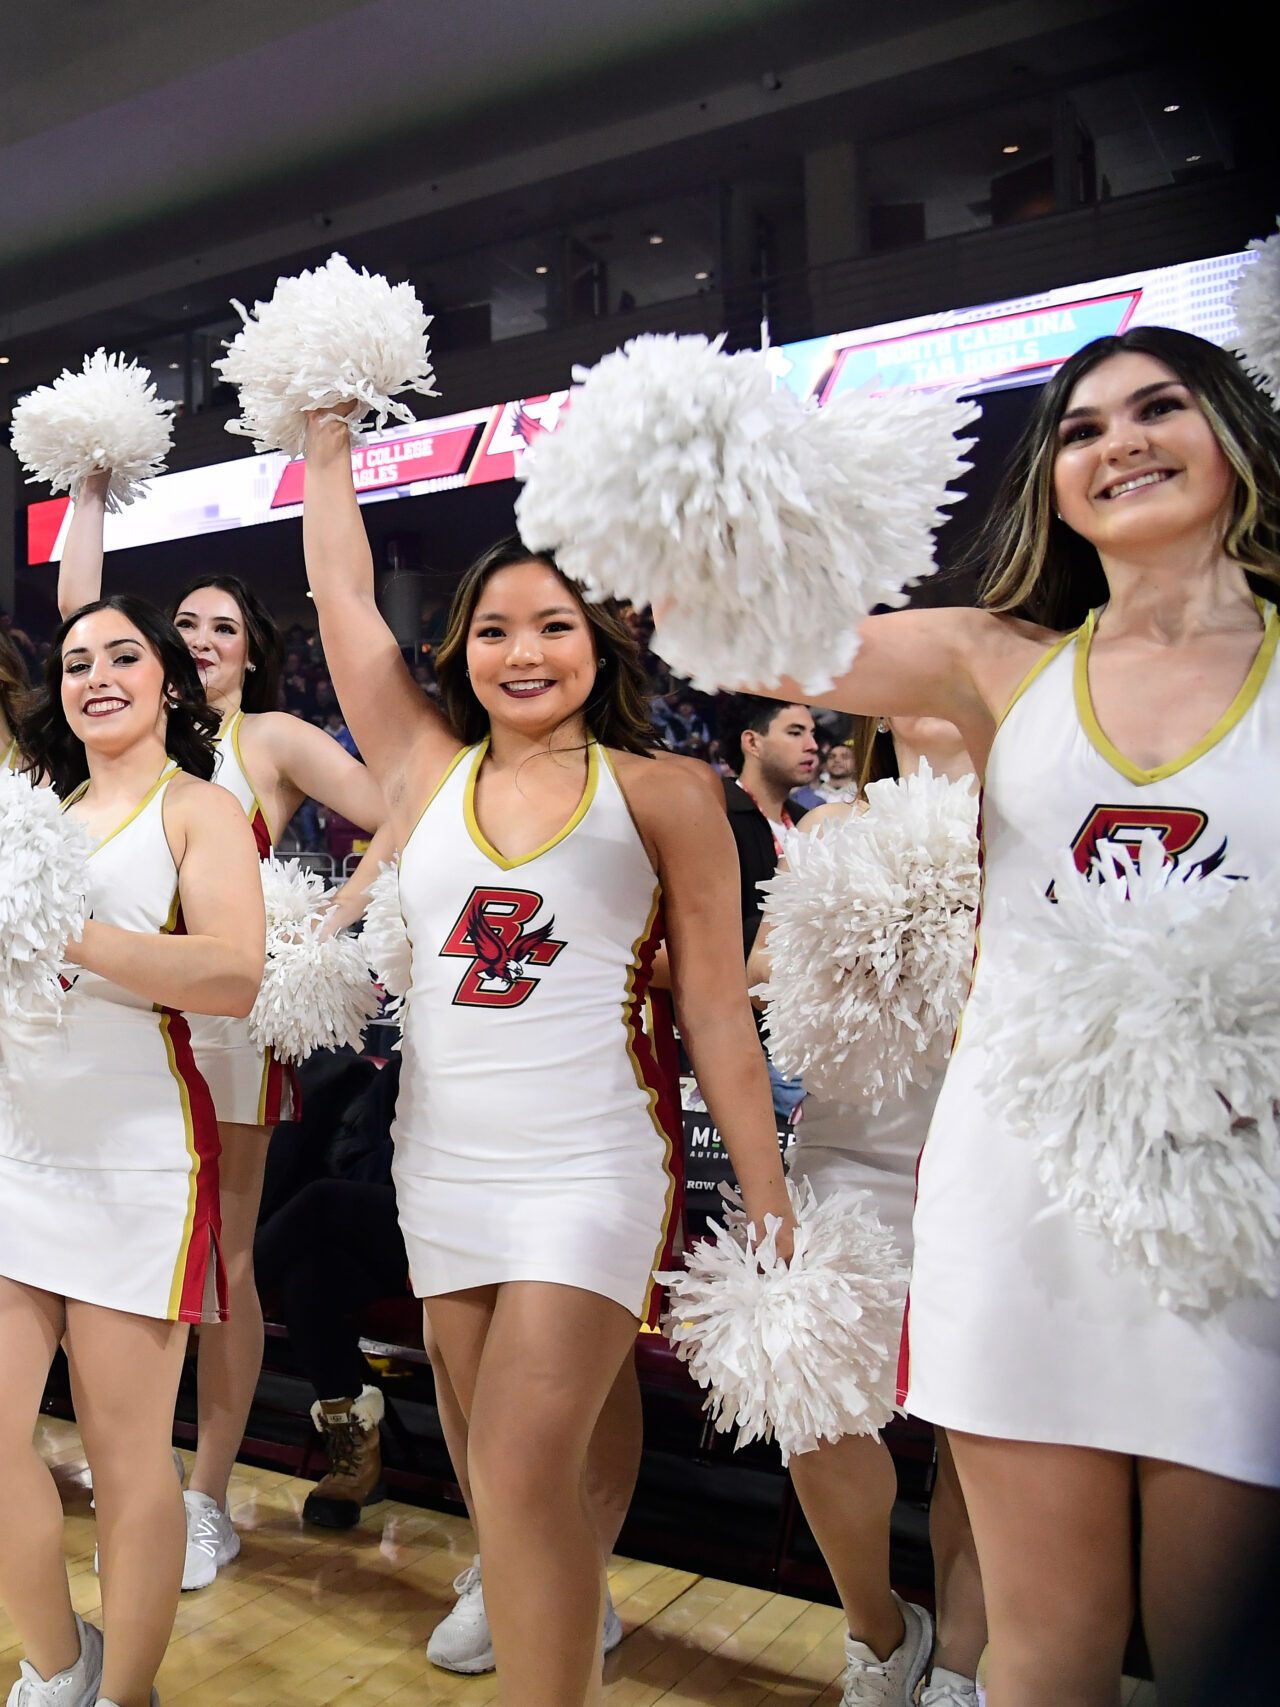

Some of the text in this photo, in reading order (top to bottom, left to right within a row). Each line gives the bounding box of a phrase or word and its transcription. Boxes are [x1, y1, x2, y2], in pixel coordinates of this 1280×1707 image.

[876, 311, 1076, 368] NORTH CAROLINA
[915, 341, 1040, 381] TAR HEELS
[366, 438, 434, 467] COLLEGE
[686, 1180, 716, 1191] ROW
